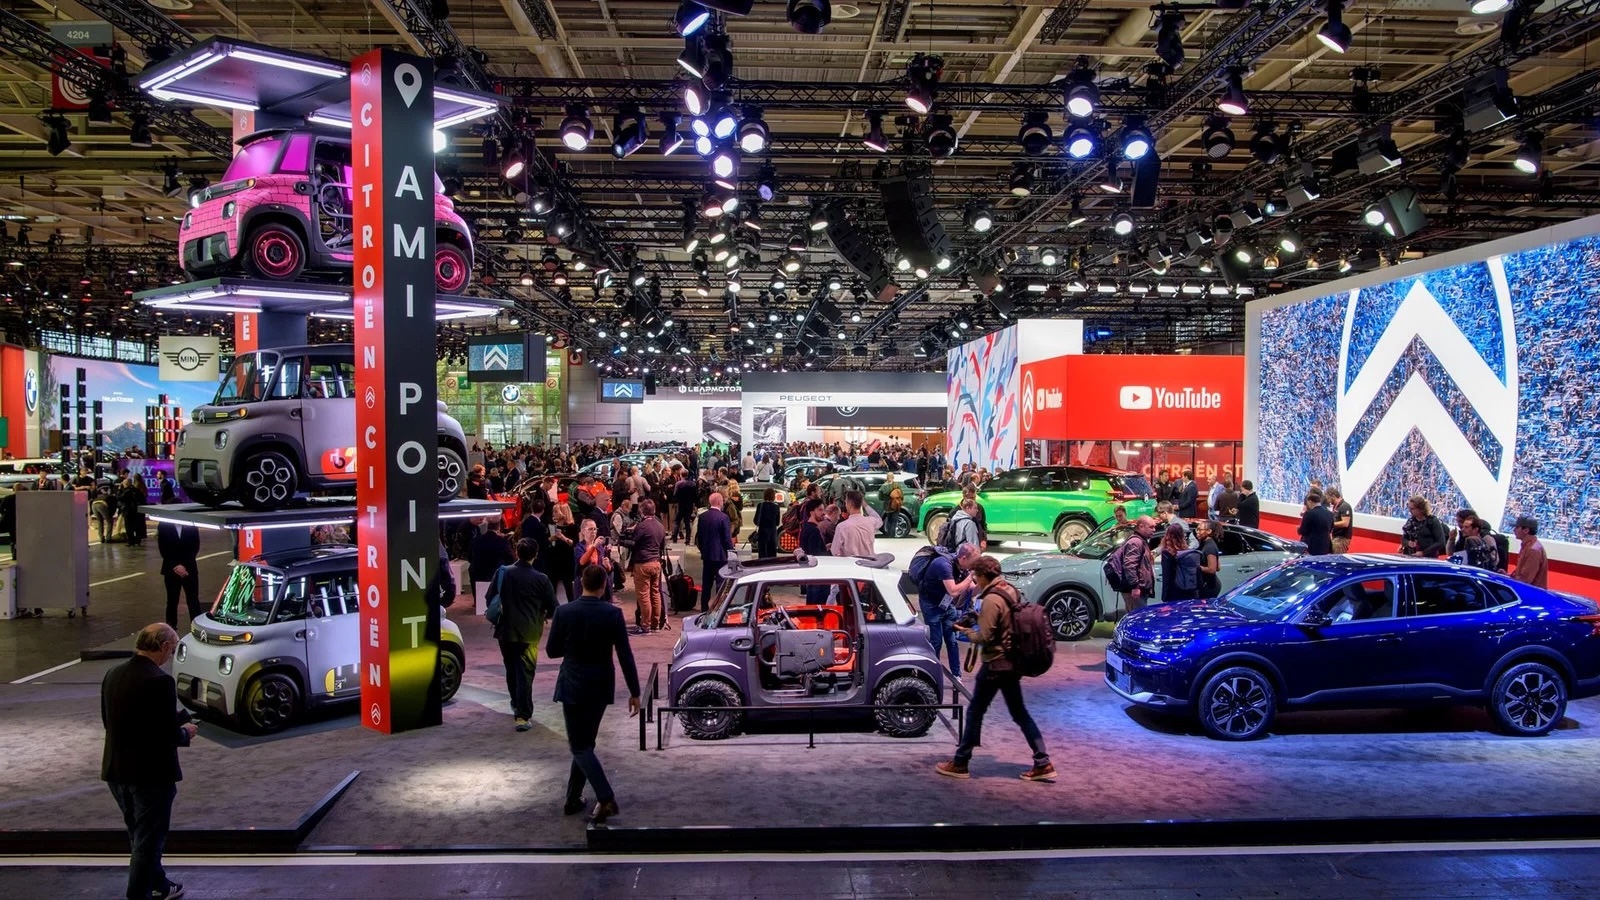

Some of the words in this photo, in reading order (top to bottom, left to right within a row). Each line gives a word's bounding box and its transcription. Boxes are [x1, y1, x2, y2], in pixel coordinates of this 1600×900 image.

[67, 30, 89, 40] 4204
[360, 102, 376, 369] CITROËN
[393, 165, 425, 317] AMI
[180, 355, 198, 363] MINI
[687, 385, 742, 394] LEAPMOTOR
[1155, 386, 1222, 409] YouTube
[364, 425, 381, 687] CITROËN
[396, 382, 427, 648] POINT
